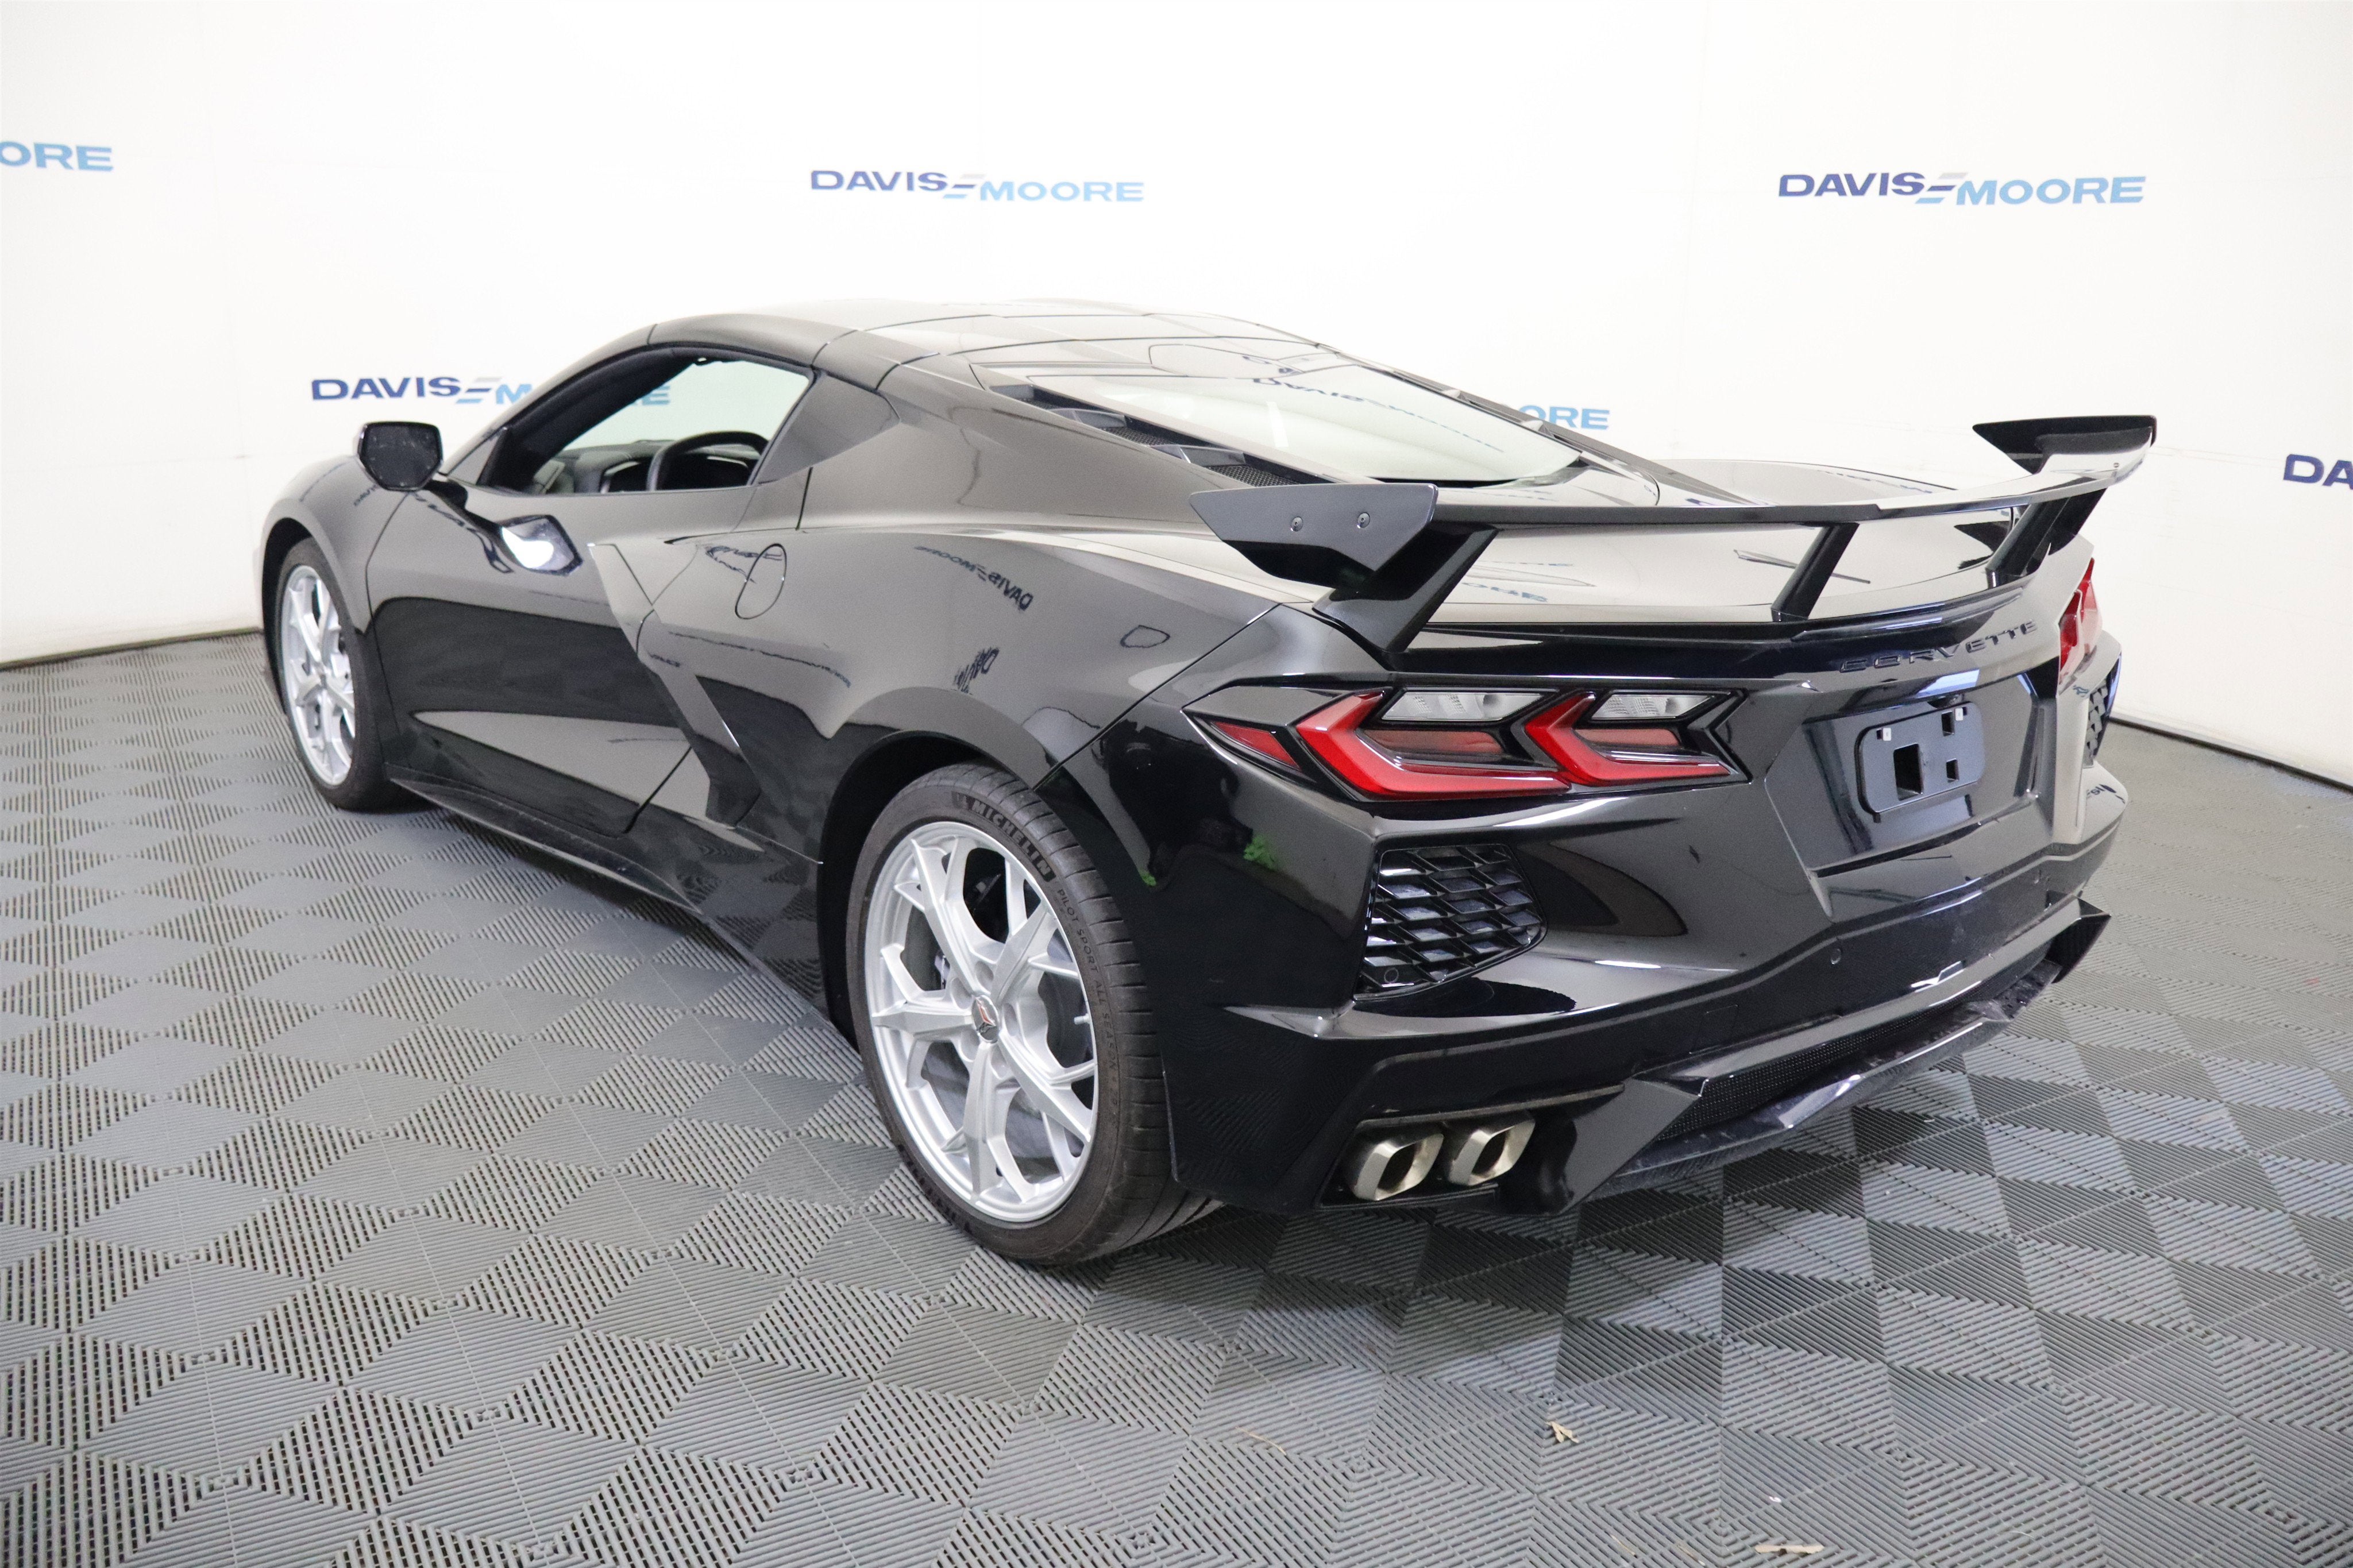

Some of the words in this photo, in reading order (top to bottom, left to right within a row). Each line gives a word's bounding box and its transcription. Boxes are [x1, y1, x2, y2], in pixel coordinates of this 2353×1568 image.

[1839, 619, 2038, 673] CORVETTE
[971, 800, 1051, 876] MICHELIN
[1058, 889, 1079, 921] PILOT
[1077, 929, 1098, 973] SPORT
[1095, 979, 1108, 1005] ALL
